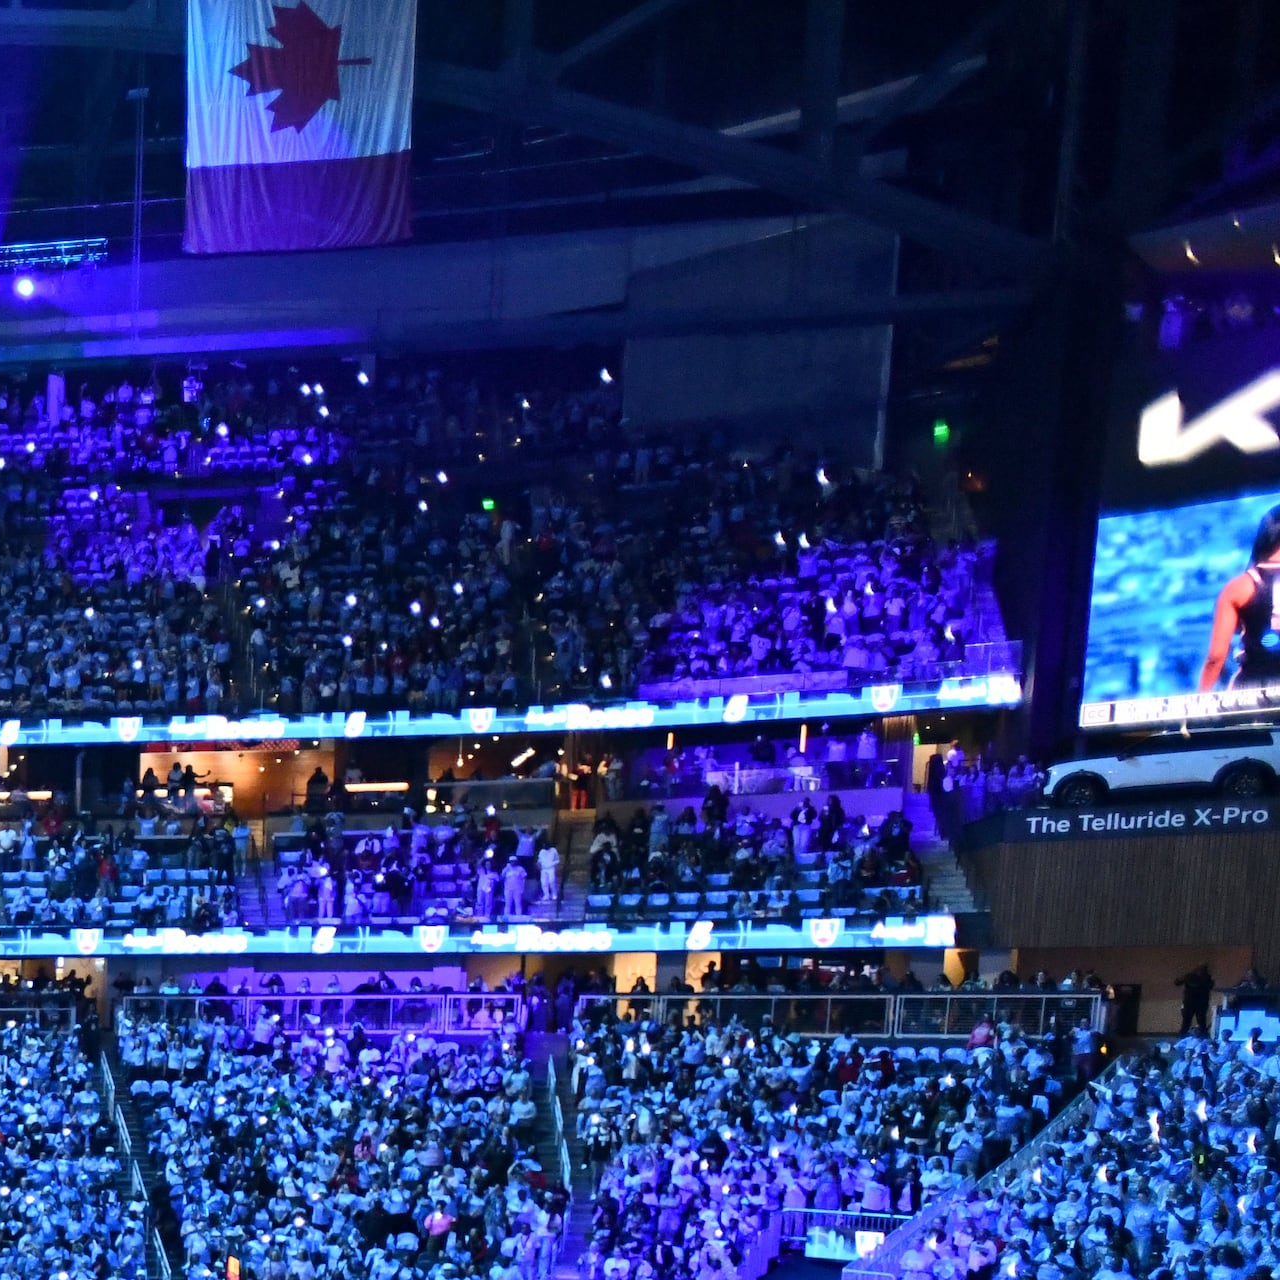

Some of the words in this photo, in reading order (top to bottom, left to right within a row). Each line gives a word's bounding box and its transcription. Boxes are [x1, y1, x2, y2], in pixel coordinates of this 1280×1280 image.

[1026, 814, 1071, 834] The
[1079, 811, 1186, 832] Telluride
[1193, 806, 1269, 826] X-Pro
